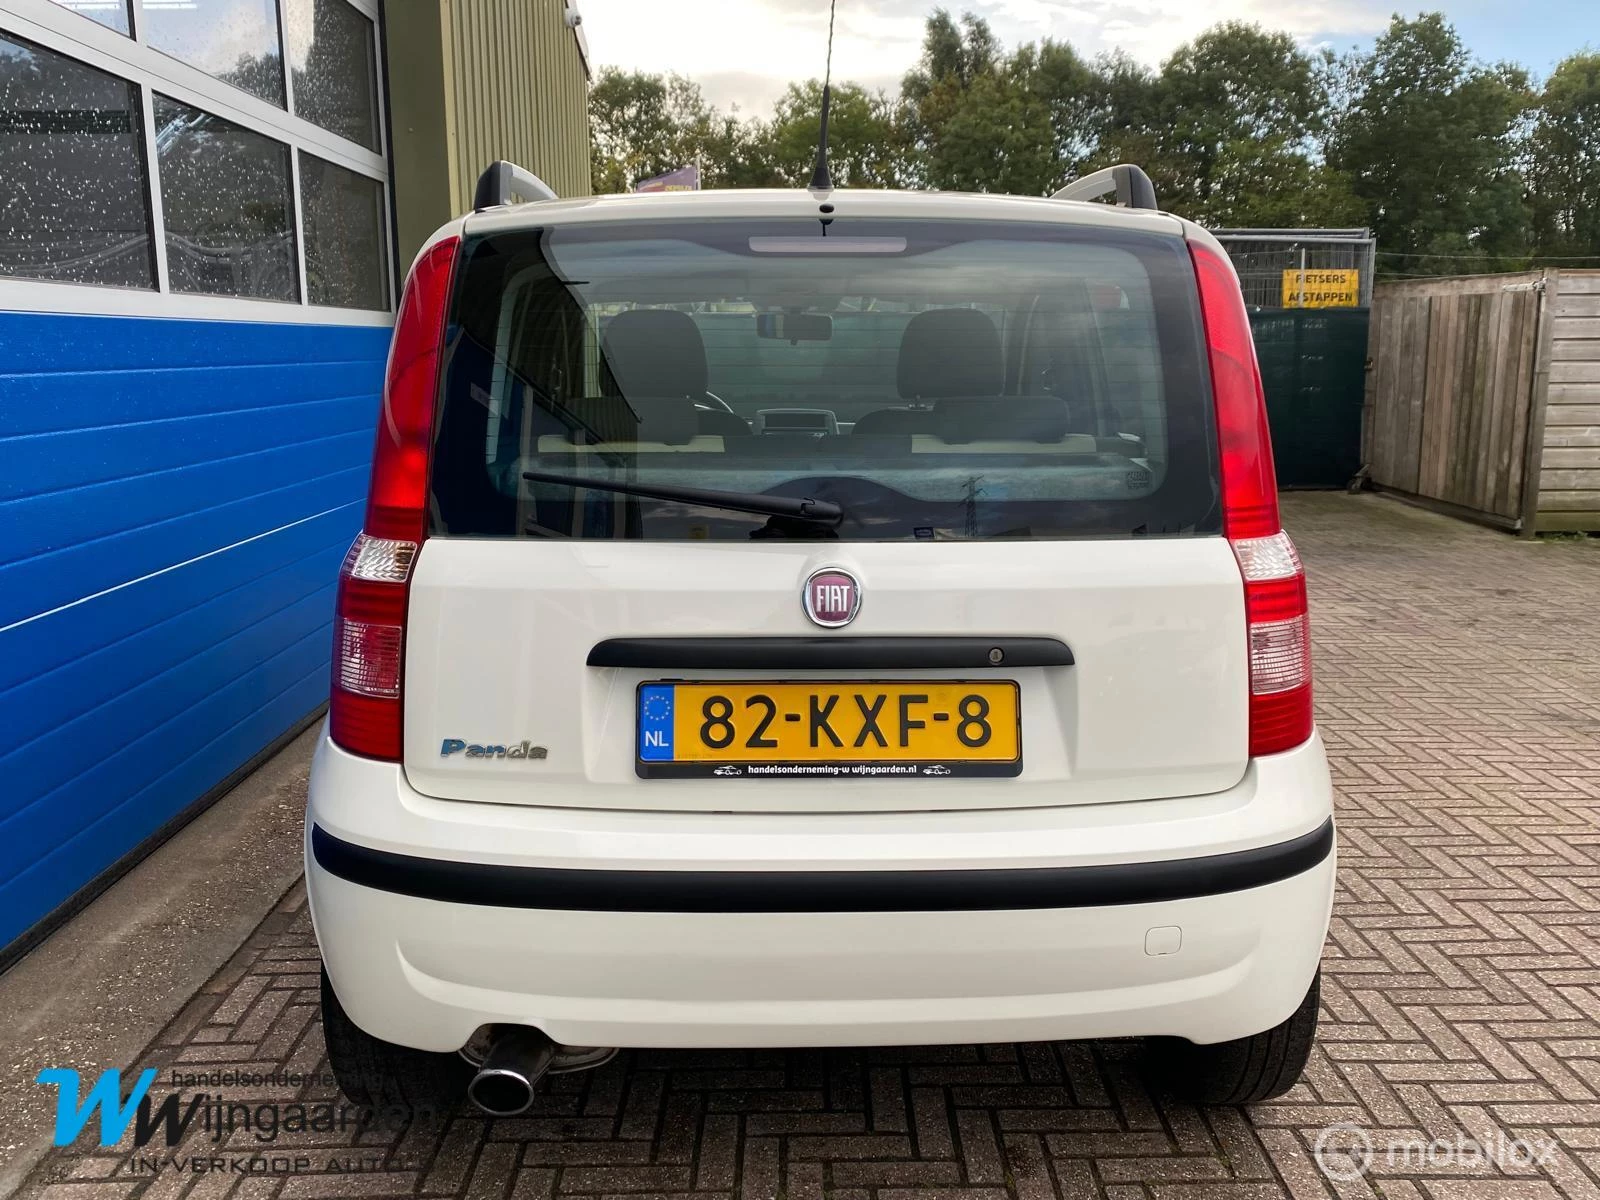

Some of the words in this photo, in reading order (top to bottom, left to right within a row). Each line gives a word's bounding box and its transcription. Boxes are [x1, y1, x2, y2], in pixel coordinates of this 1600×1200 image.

[816, 585, 850, 612] FIAT
[700, 694, 992, 749] 82-KXF-8
[440, 738, 548, 760] Panda
[645, 731, 669, 747] NL
[852, 765, 917, 775] wijngaarden.nl
